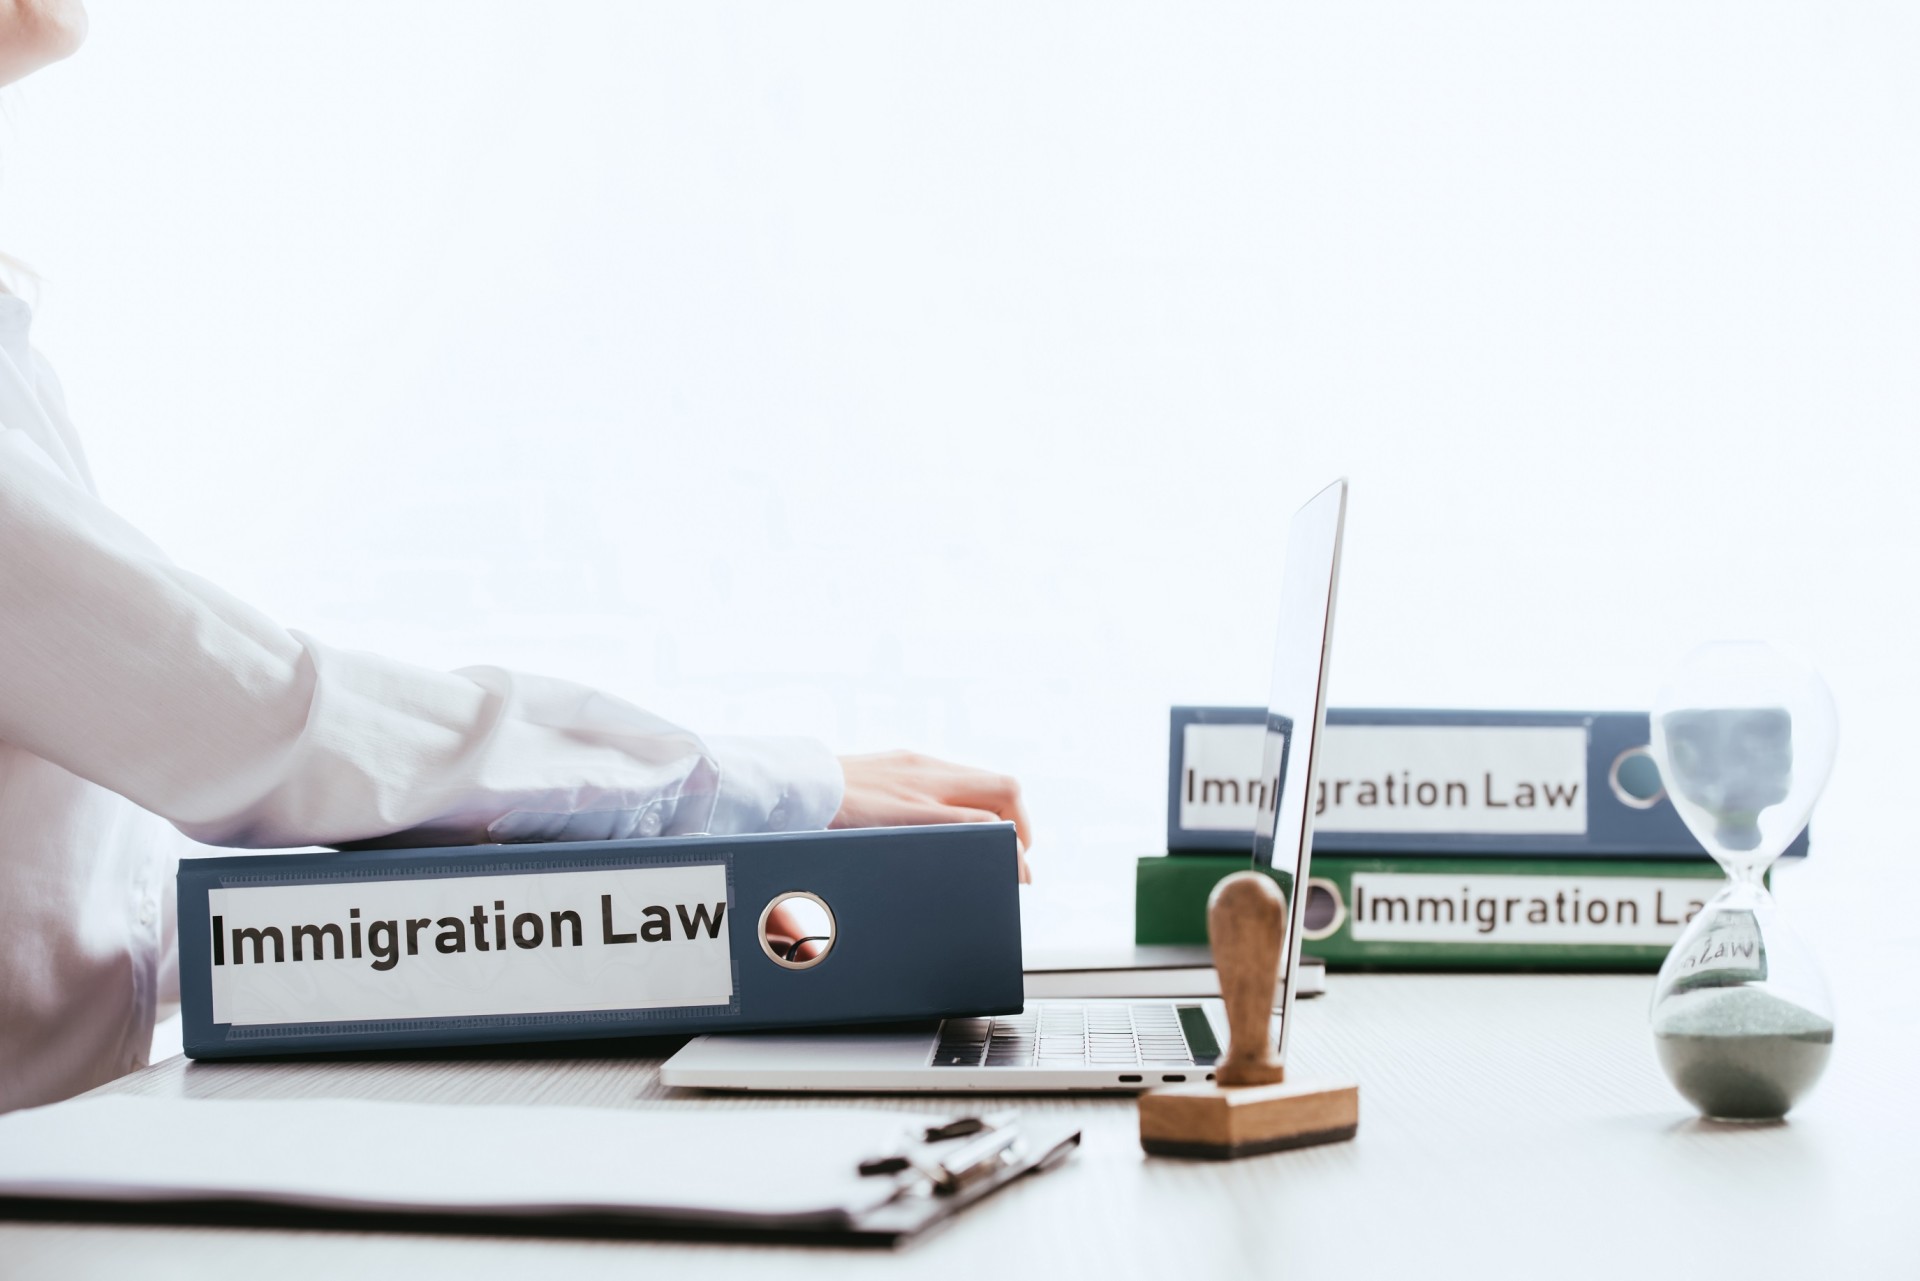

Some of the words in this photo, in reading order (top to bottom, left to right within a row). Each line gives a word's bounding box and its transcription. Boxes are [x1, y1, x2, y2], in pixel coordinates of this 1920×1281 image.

[1187, 768, 1468, 816] Imgration
[1485, 772, 1579, 808] Law
[212, 901, 583, 972] Immigration
[602, 894, 728, 945] Law
[1355, 886, 1639, 935] Immigration
[1655, 890, 1704, 925] La
